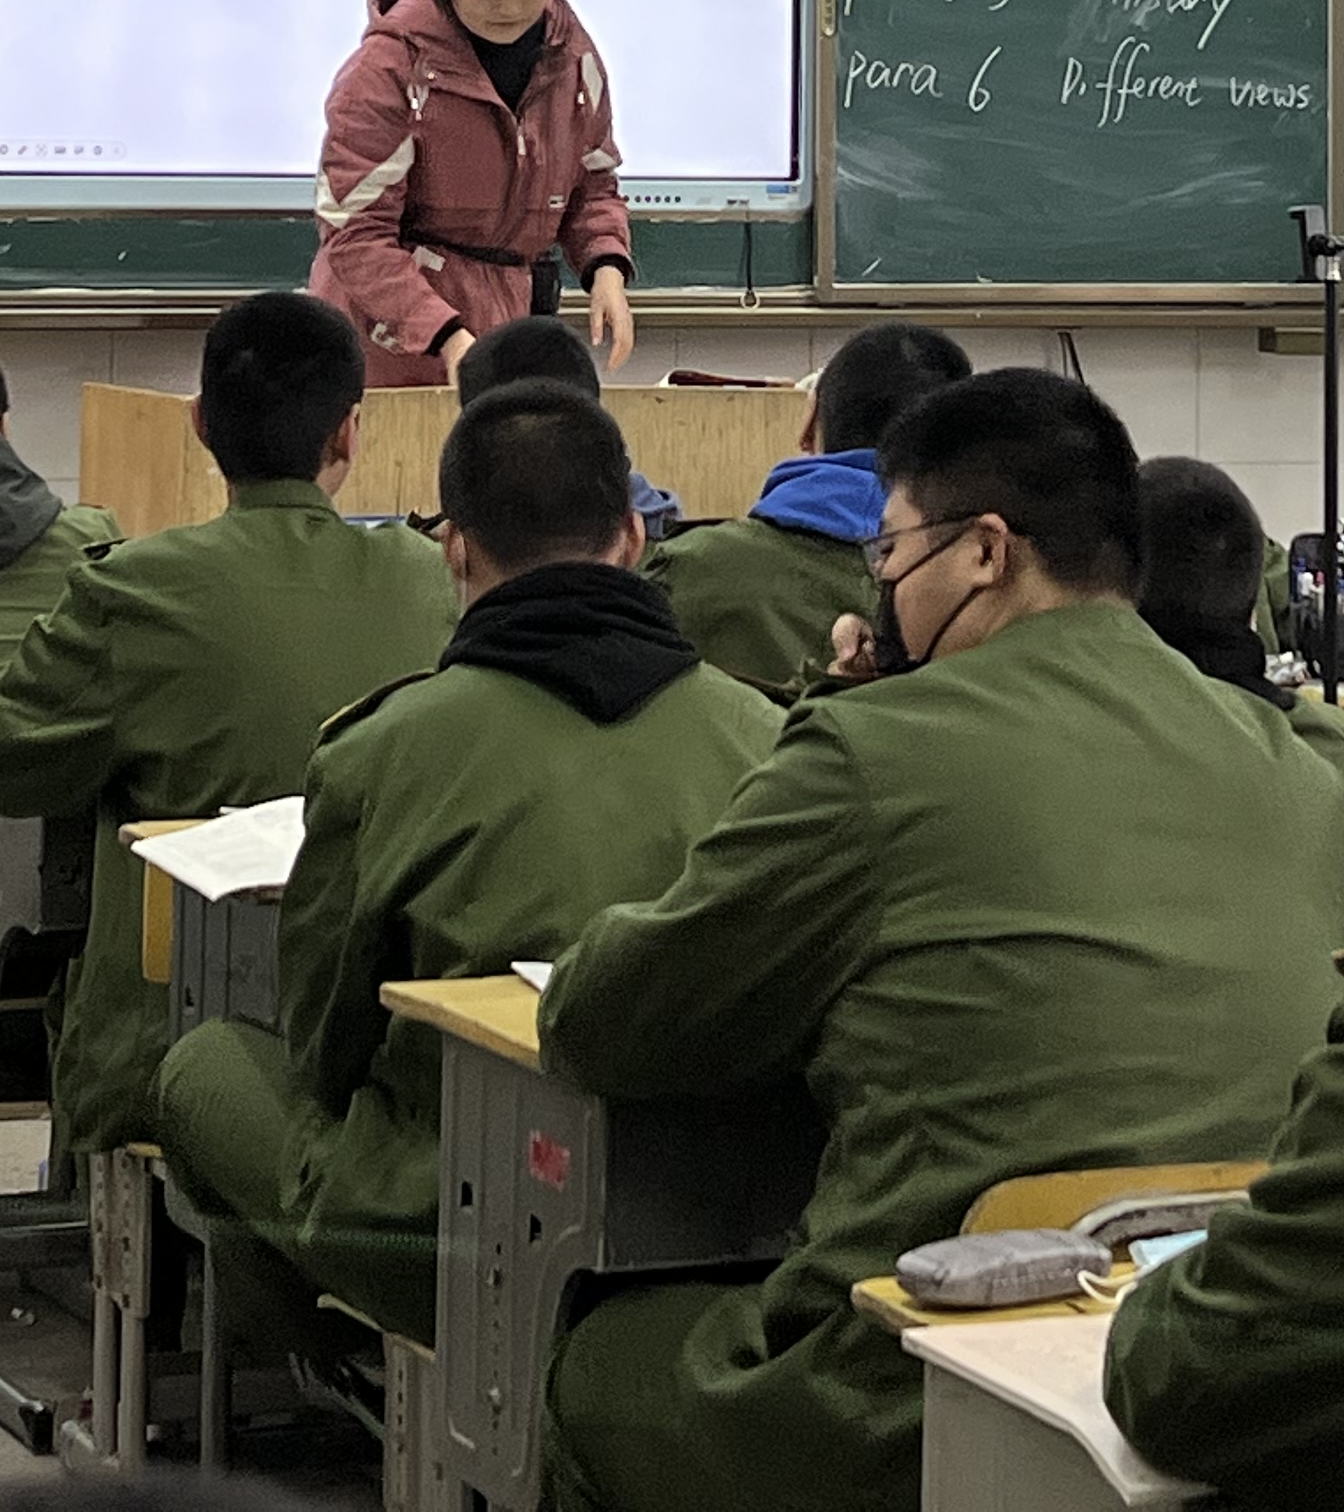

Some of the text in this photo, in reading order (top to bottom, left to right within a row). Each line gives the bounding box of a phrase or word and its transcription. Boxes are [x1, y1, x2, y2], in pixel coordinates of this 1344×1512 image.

[844, 45, 1002, 112] para 6
[1061, 37, 1312, 128] Different views
